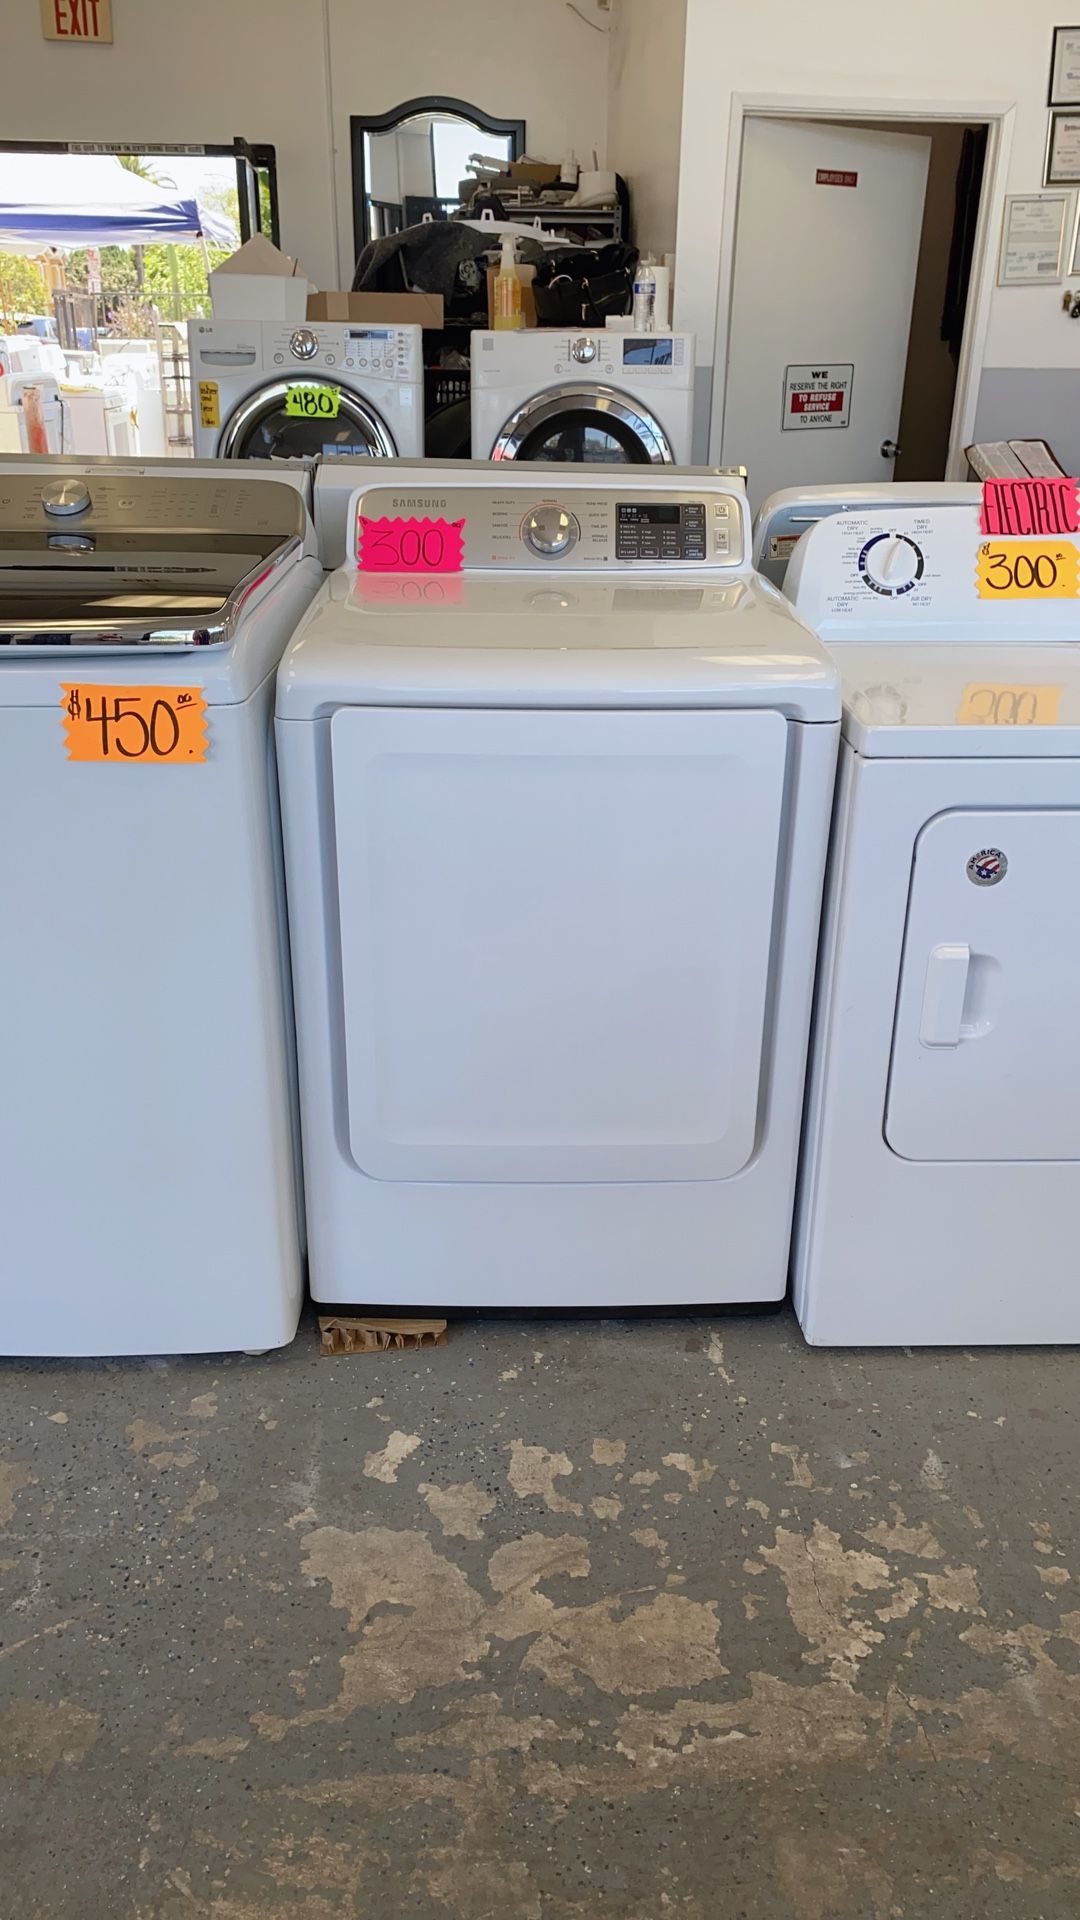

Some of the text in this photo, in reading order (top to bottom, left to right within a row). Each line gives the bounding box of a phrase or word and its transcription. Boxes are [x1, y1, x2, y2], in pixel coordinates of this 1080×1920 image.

[54, 0, 98, 36] EXIT
[804, 403, 830, 411] SERVICE
[392, 499, 446, 508] SAMSUNG
[985, 481, 1078, 535] ELECTRIC
[969, 849, 1000, 870] AMERICA
